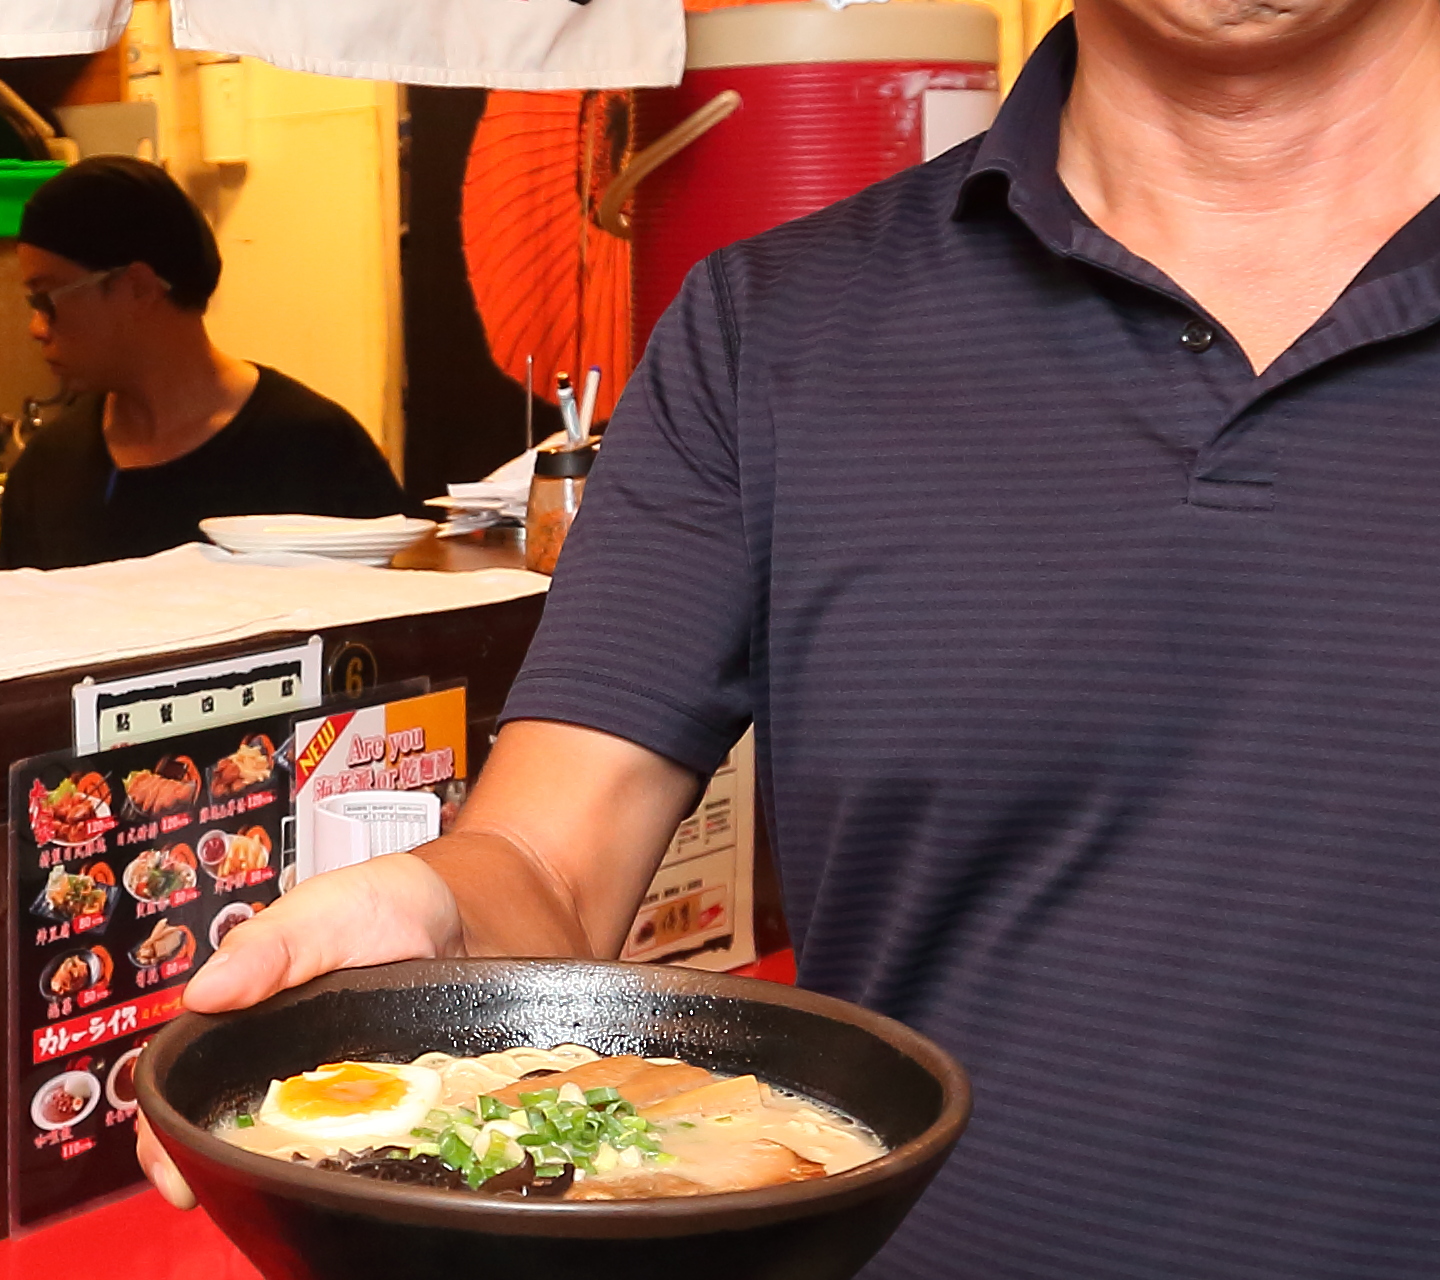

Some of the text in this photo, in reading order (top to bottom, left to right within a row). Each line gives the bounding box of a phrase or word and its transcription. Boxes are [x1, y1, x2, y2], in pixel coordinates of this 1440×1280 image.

[345, 657, 364, 700] 6
[299, 721, 336, 776] NEW
[347, 727, 424, 767] Are you
[374, 769, 398, 790] or
[38, 1006, 138, 1056] カレーライス
